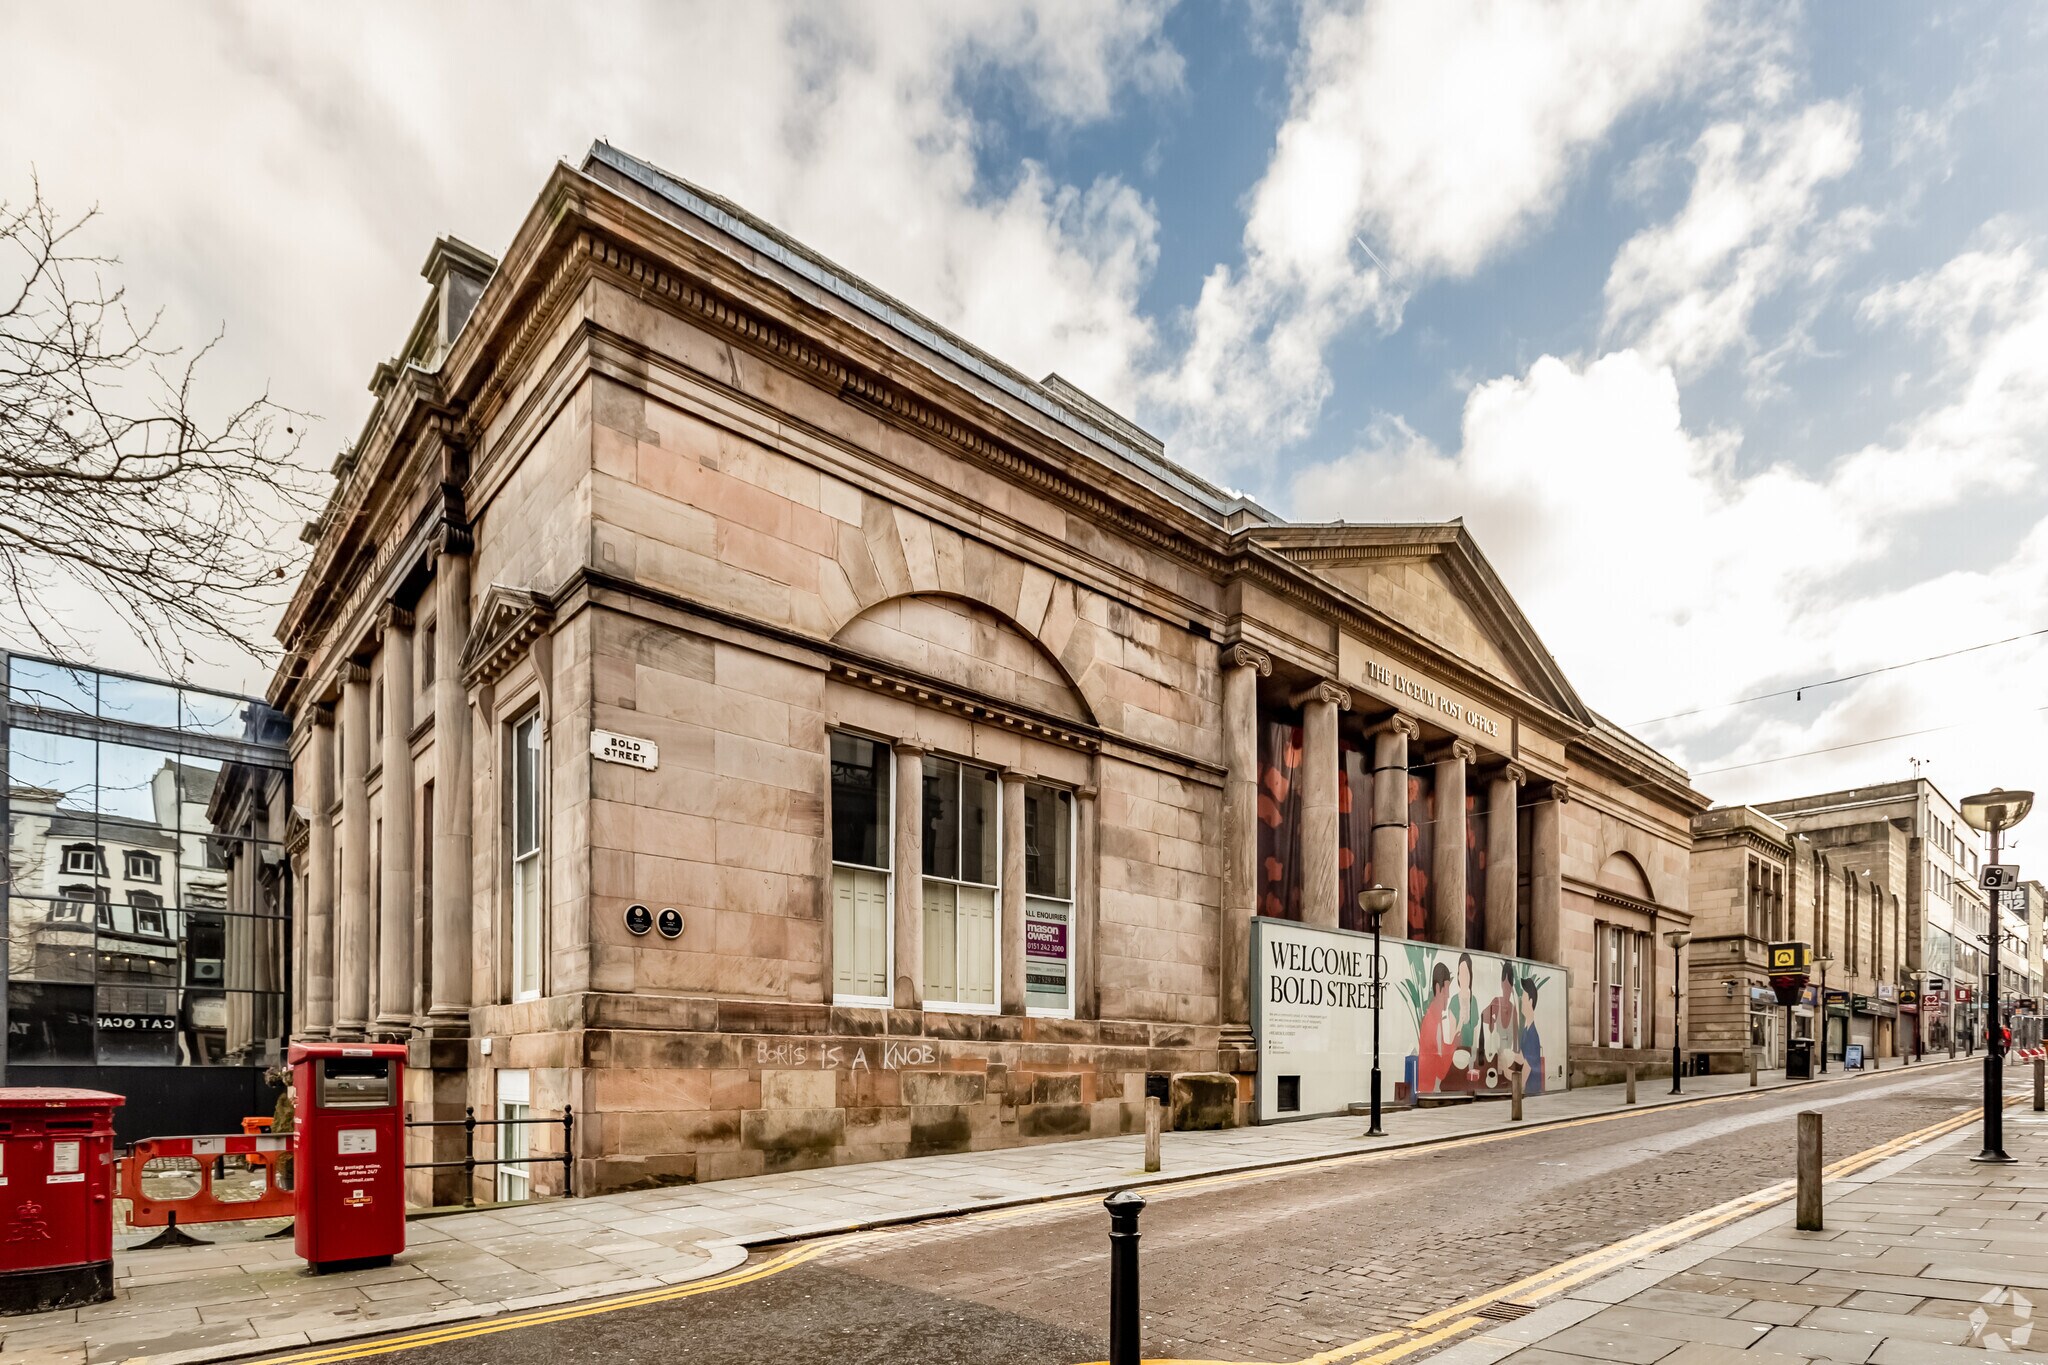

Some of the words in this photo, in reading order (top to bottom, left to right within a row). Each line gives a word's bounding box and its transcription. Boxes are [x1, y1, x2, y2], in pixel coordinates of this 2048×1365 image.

[1367, 660, 1391, 686] THE
[1394, 673, 1437, 708] LYCEUM
[1439, 695, 1463, 720] POST
[1466, 710, 1499, 737] OFFICE
[611, 738, 641, 751] BOLD
[604, 747, 647, 763] STREET
[1037, 911, 1067, 921] ENQUIRIES
[1027, 923, 1059, 935] mason
[1027, 932, 1053, 942] owen
[1027, 942, 1040, 950] 0151
[1040, 943, 1051, 951] 242
[1051, 945, 1065, 953] 3000
[1270, 940, 1362, 977] WELCOME
[1366, 953, 1388, 980] TO
[1270, 975, 1323, 1006] BOLD
[1327, 980, 1387, 1010] STREET
[851, 1047, 871, 1075] A
[883, 1040, 936, 1075] KNOB
